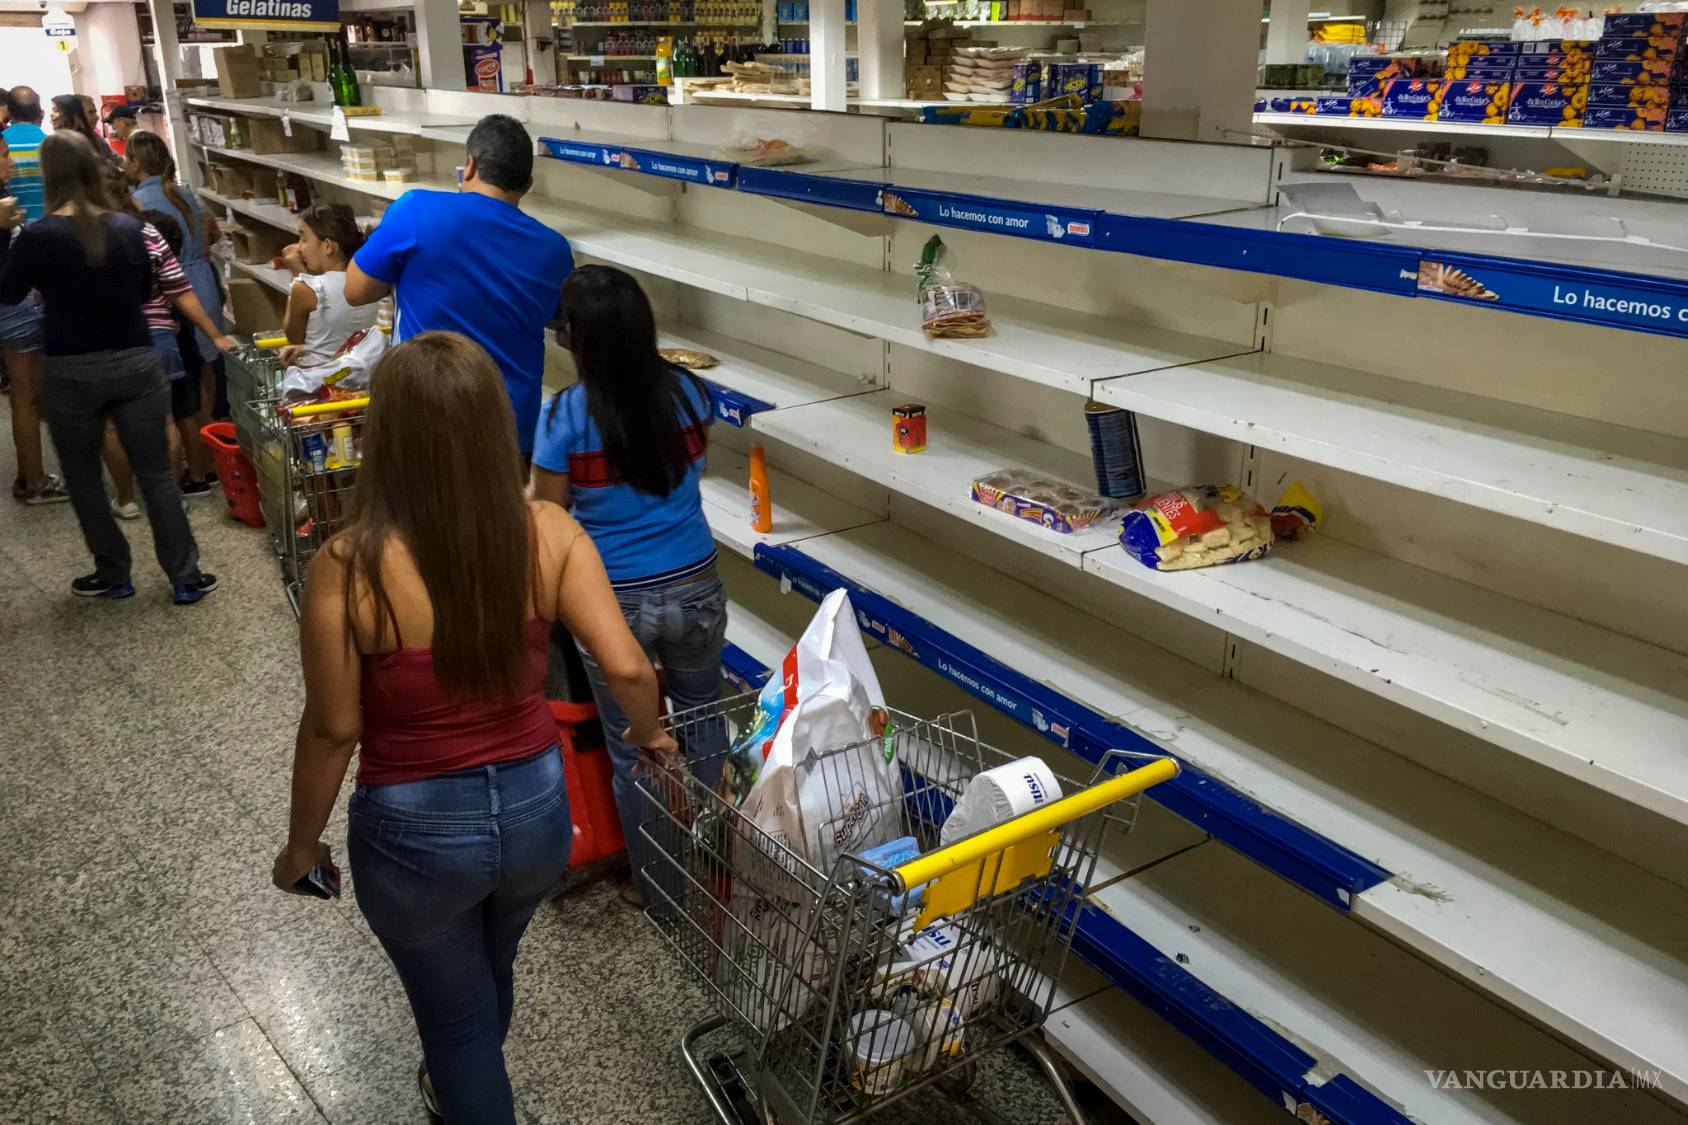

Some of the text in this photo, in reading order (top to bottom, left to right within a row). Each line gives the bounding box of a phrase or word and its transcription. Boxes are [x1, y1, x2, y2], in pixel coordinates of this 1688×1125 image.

[226, 0, 312, 17] Gelatinas
[939, 205, 1029, 228] Lo hacemos con amor
[1553, 286, 1578, 305] Lo
[1583, 290, 1671, 319] hacemos
[938, 658, 1018, 710] Lo hacemos con amor
